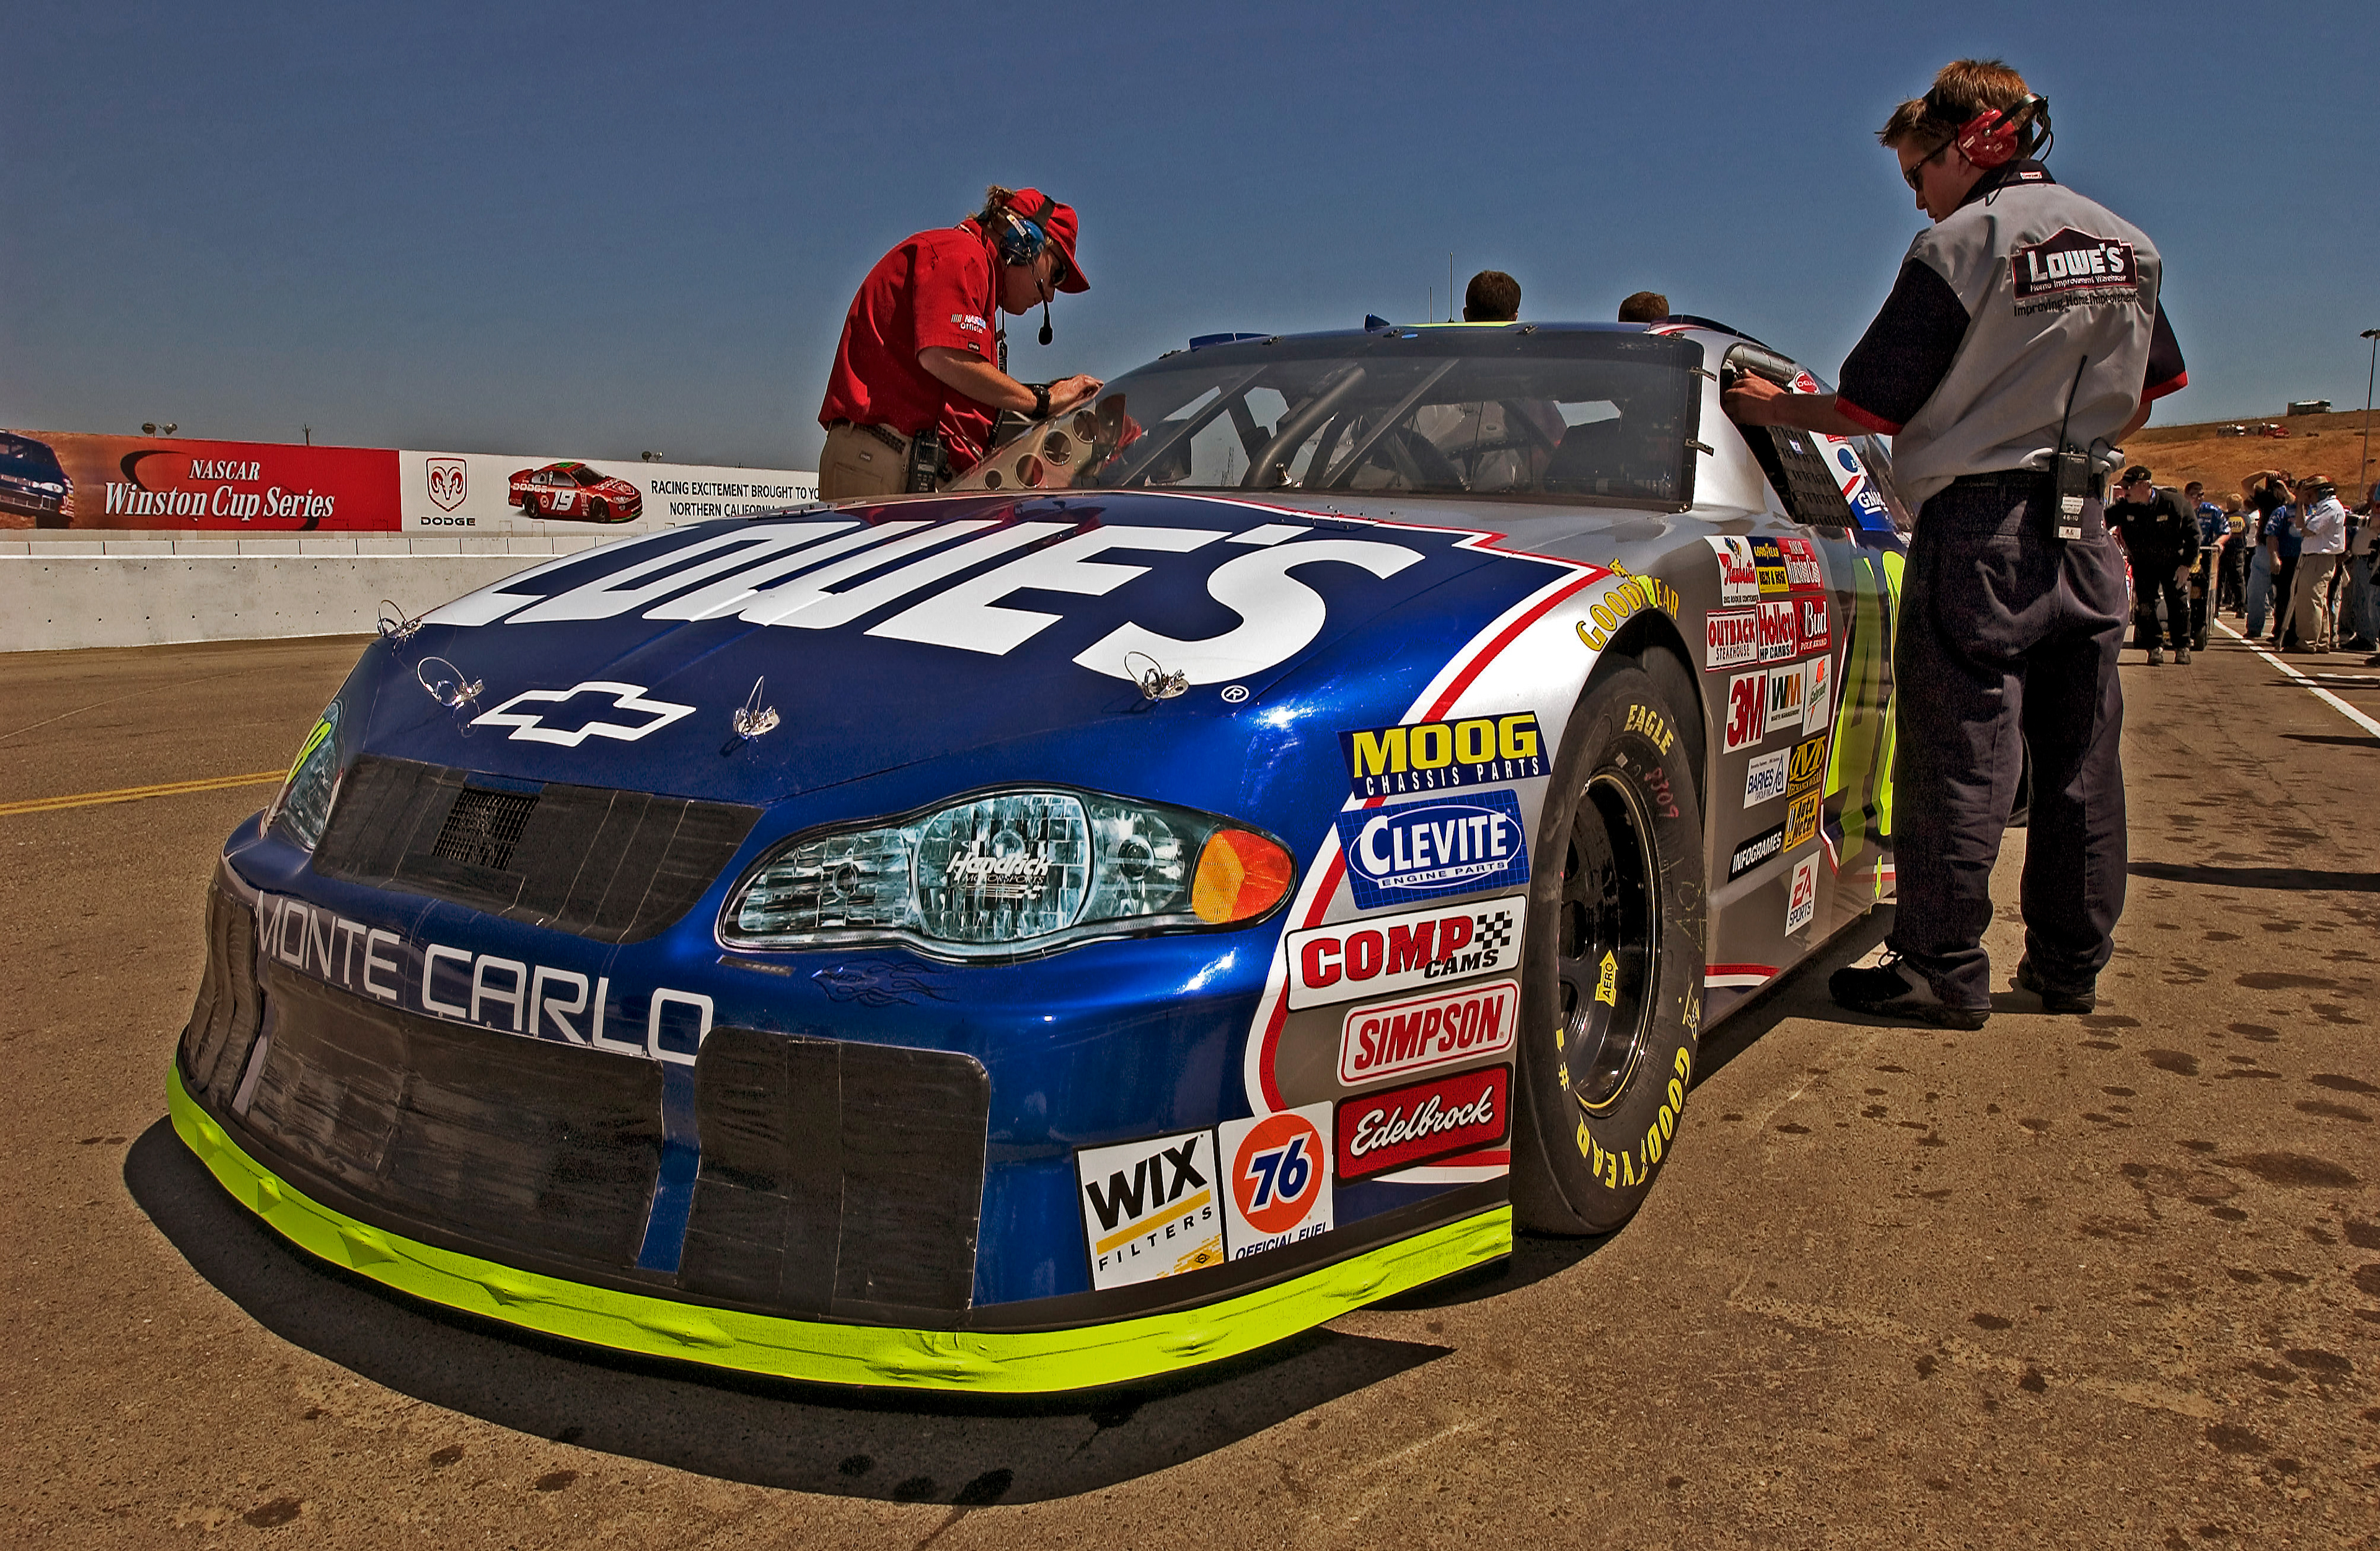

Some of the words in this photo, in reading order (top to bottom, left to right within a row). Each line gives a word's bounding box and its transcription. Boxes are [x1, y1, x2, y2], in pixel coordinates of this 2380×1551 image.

[2027, 242, 2125, 282] LOWE'S
[2014, 299, 2066, 317] Improving
[2066, 293, 2089, 307] Home
[2030, 282, 2052, 293] Home
[188, 459, 260, 479] NASCAR
[104, 481, 208, 517] Winston
[212, 485, 259, 521] Cup
[263, 488, 335, 518] Series
[550, 490, 576, 511] 19
[651, 480, 689, 495] RACING
[692, 482, 749, 497] EXCITEMENT
[751, 484, 793, 499] BROUGHT
[795, 486, 806, 500] TO
[808, 487, 819, 500] YO
[670, 502, 721, 516] NORTHERN
[420, 516, 476, 526] DODGE
[420, 519, 1426, 686] LOWE'S
[1804, 601, 1828, 637] Bud
[1708, 617, 1756, 648] OUTBACK
[1757, 604, 1796, 655] Holley
[1716, 644, 1750, 661] STEAKHOUSE
[1760, 647, 1769, 661] HP
[1770, 644, 1790, 658] CARBS
[1727, 674, 1766, 748] 3M
[1772, 673, 1802, 712] WM
[1352, 714, 1538, 779] MOOG
[1624, 704, 1674, 756] EAGLE
[1366, 766, 1460, 797] CHASSIS
[1476, 757, 1540, 782] PARTS
[1748, 768, 1774, 795] BARNES
[1359, 813, 1507, 875] CLEVITE
[1732, 831, 1782, 873] INFOGRAMES
[946, 851, 1051, 881] Hendrick
[1382, 870, 1447, 886] ENGINE
[1455, 862, 1505, 876] PARTS
[1789, 900, 1812, 927] SPORTS
[1302, 915, 1473, 989] COMP
[1424, 948, 1499, 979] CAMS
[255, 890, 400, 1000] MONTE
[421, 943, 714, 1066] CARLO
[1603, 961, 1614, 999] AERO
[1353, 994, 1505, 1070] SIMPSON
[1350, 1084, 1493, 1157] Edelbrock
[1576, 1046, 1690, 1190] GOODYEAR
[1085, 1136, 1208, 1232] WIX
[1246, 1133, 1311, 1212] 76
[1098, 1206, 1212, 1272] FILTERS
[1236, 1232, 1292, 1260] OFFICIAL
